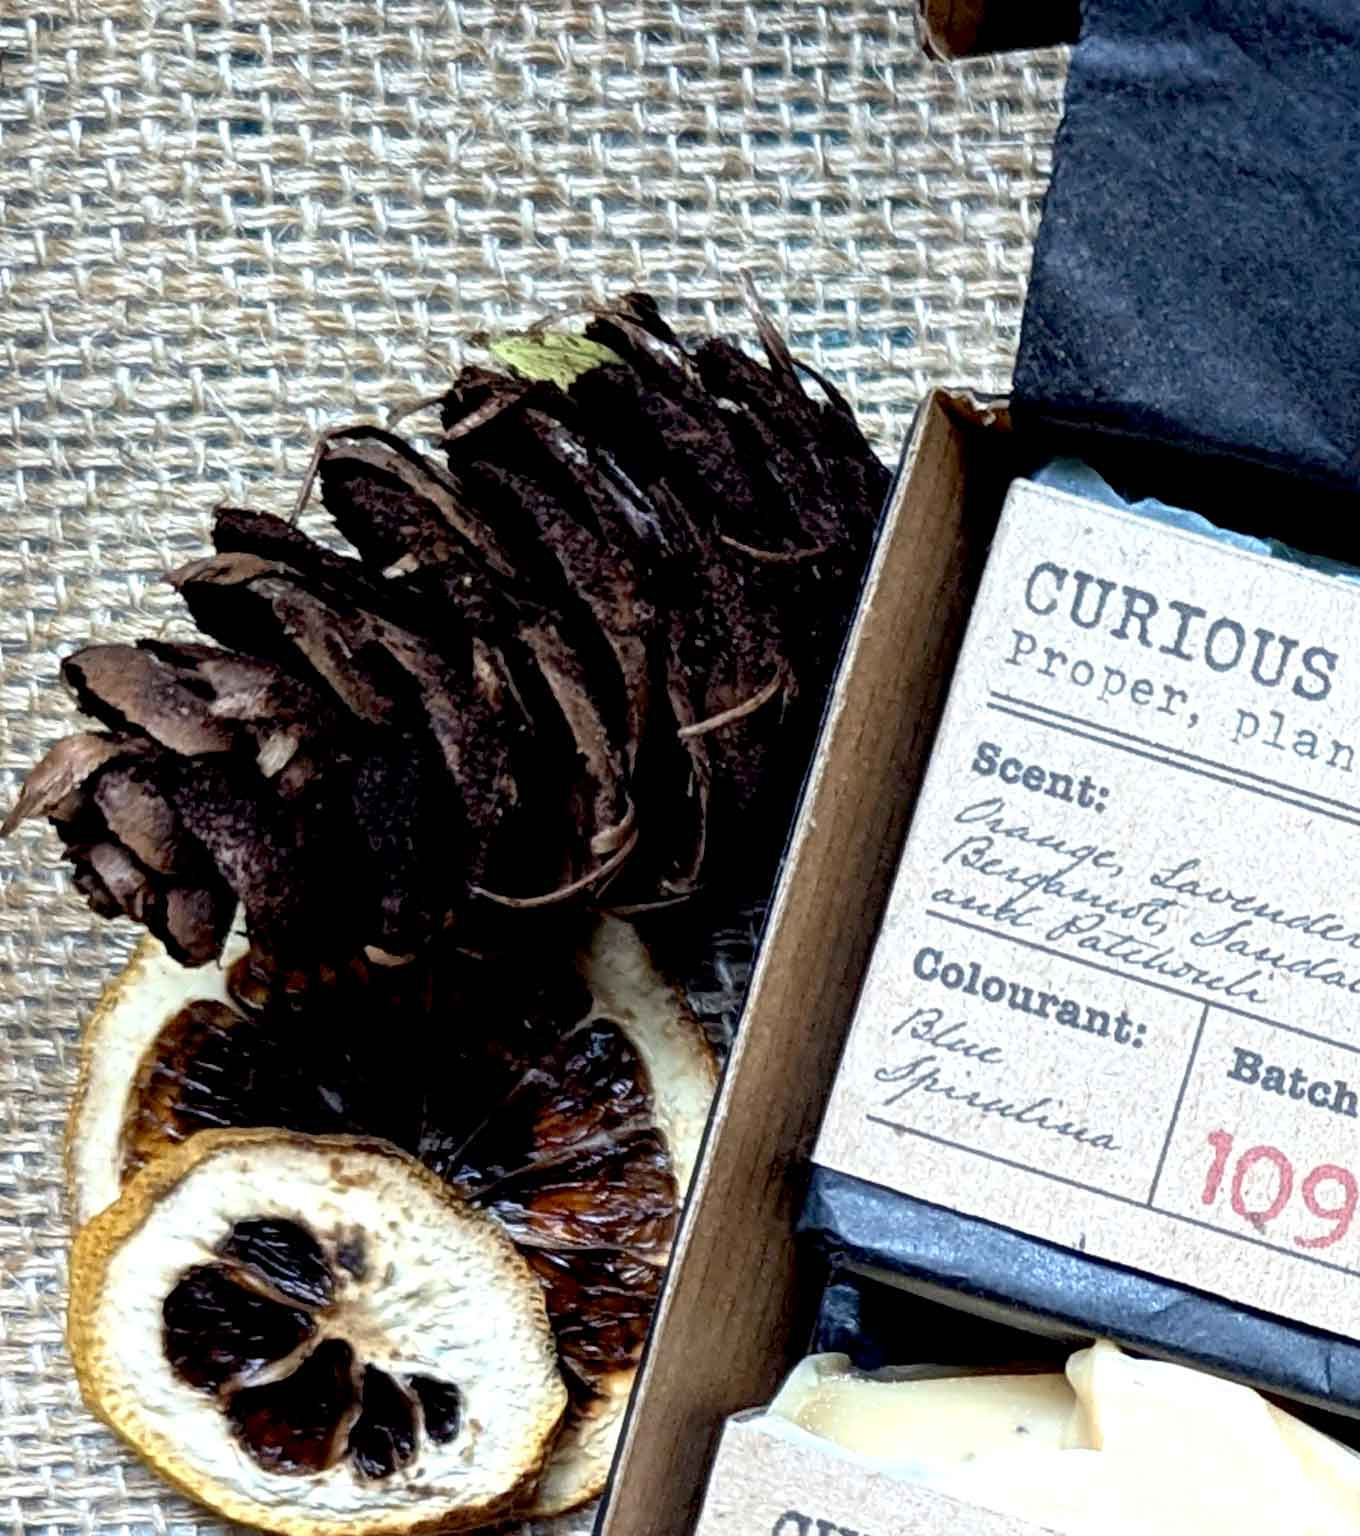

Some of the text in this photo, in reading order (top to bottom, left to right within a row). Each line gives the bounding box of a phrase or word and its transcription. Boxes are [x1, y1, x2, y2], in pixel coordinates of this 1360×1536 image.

[1003, 628, 1199, 728] Proper,
[1023, 560, 1339, 702] CURIOUS
[970, 740, 1110, 814] Scent:
[938, 834, 1172, 937] Bergamot,
[953, 796, 1124, 880] Orange,
[930, 887, 1266, 1003] and Patchouli
[890, 1007, 1002, 1064] Blue
[911, 945, 1147, 1049] Colourant:
[873, 1054, 1119, 1151] Spirulina
[1225, 1045, 1358, 1119] Batch
[1200, 1127, 1359, 1249] 109
